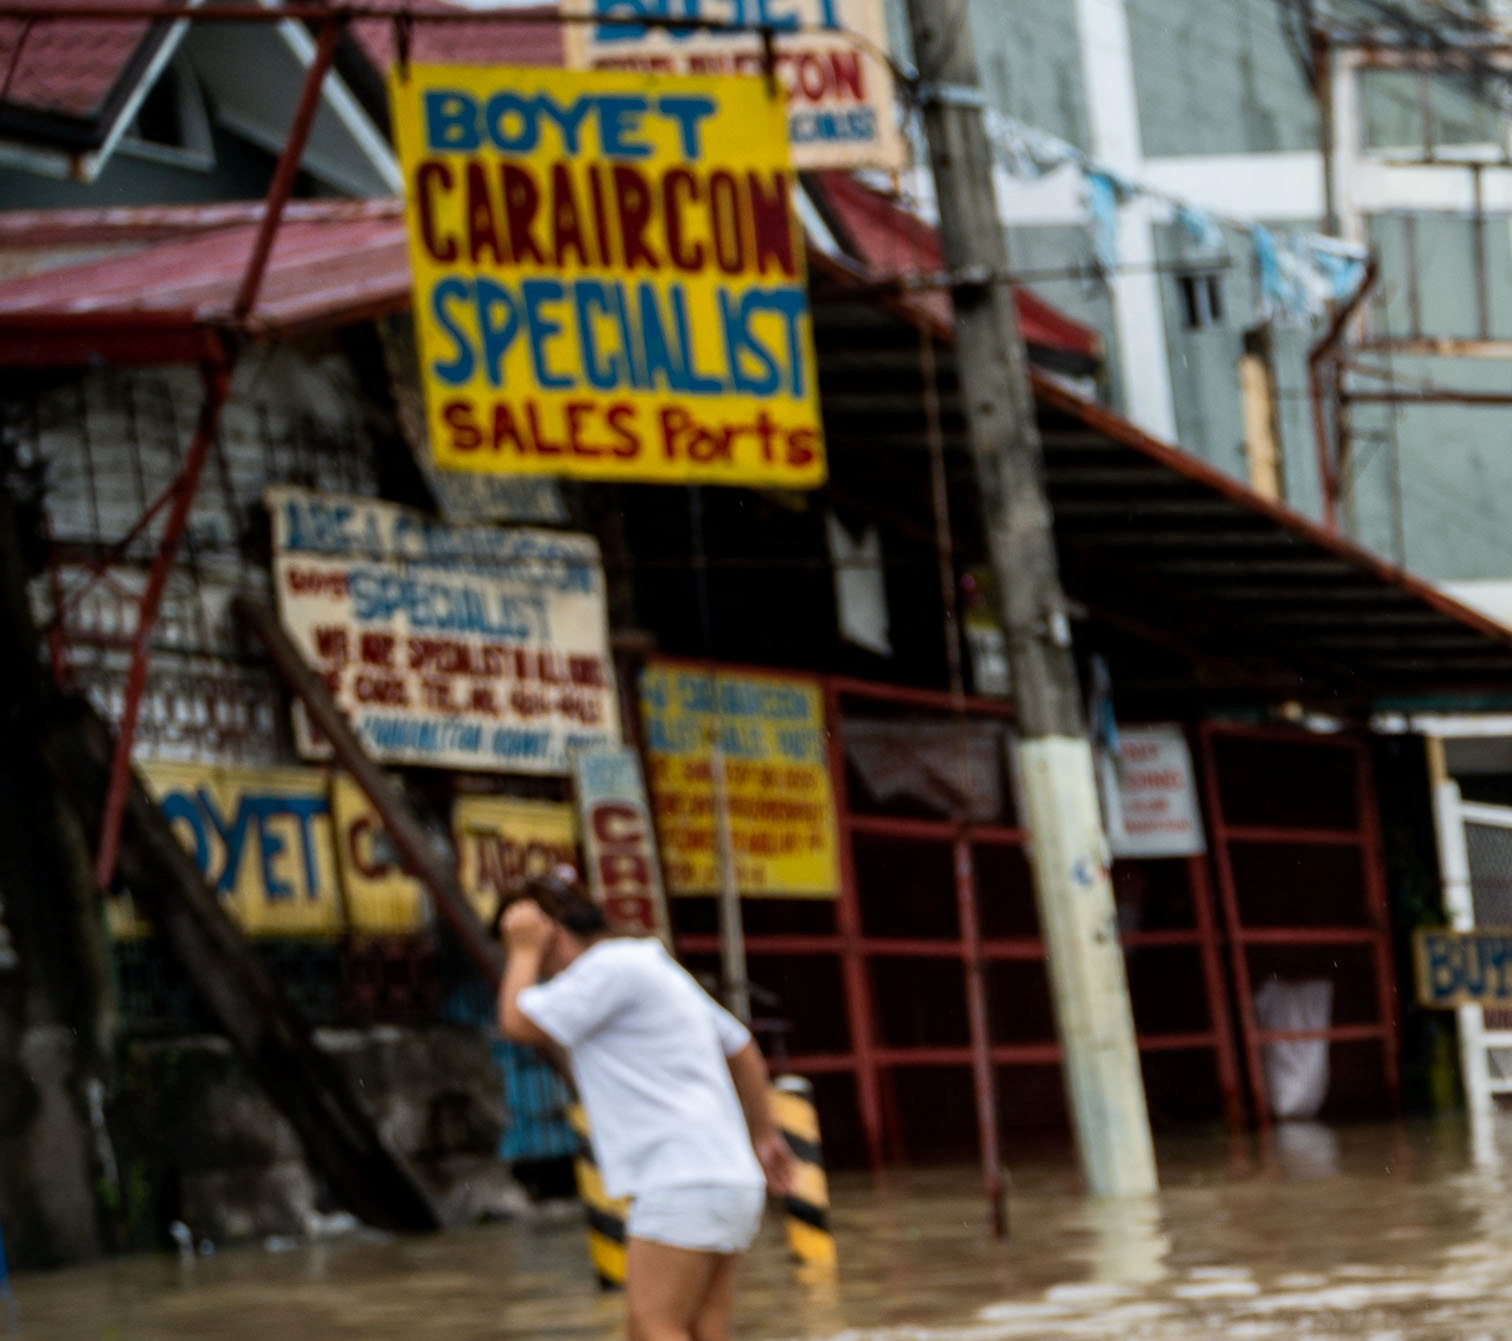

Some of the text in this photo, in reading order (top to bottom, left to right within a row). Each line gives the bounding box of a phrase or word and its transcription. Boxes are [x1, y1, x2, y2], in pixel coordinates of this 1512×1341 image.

[424, 89, 718, 160] BOYET
[429, 275, 810, 400] SPECIALIST
[442, 400, 822, 466] SALES Parts
